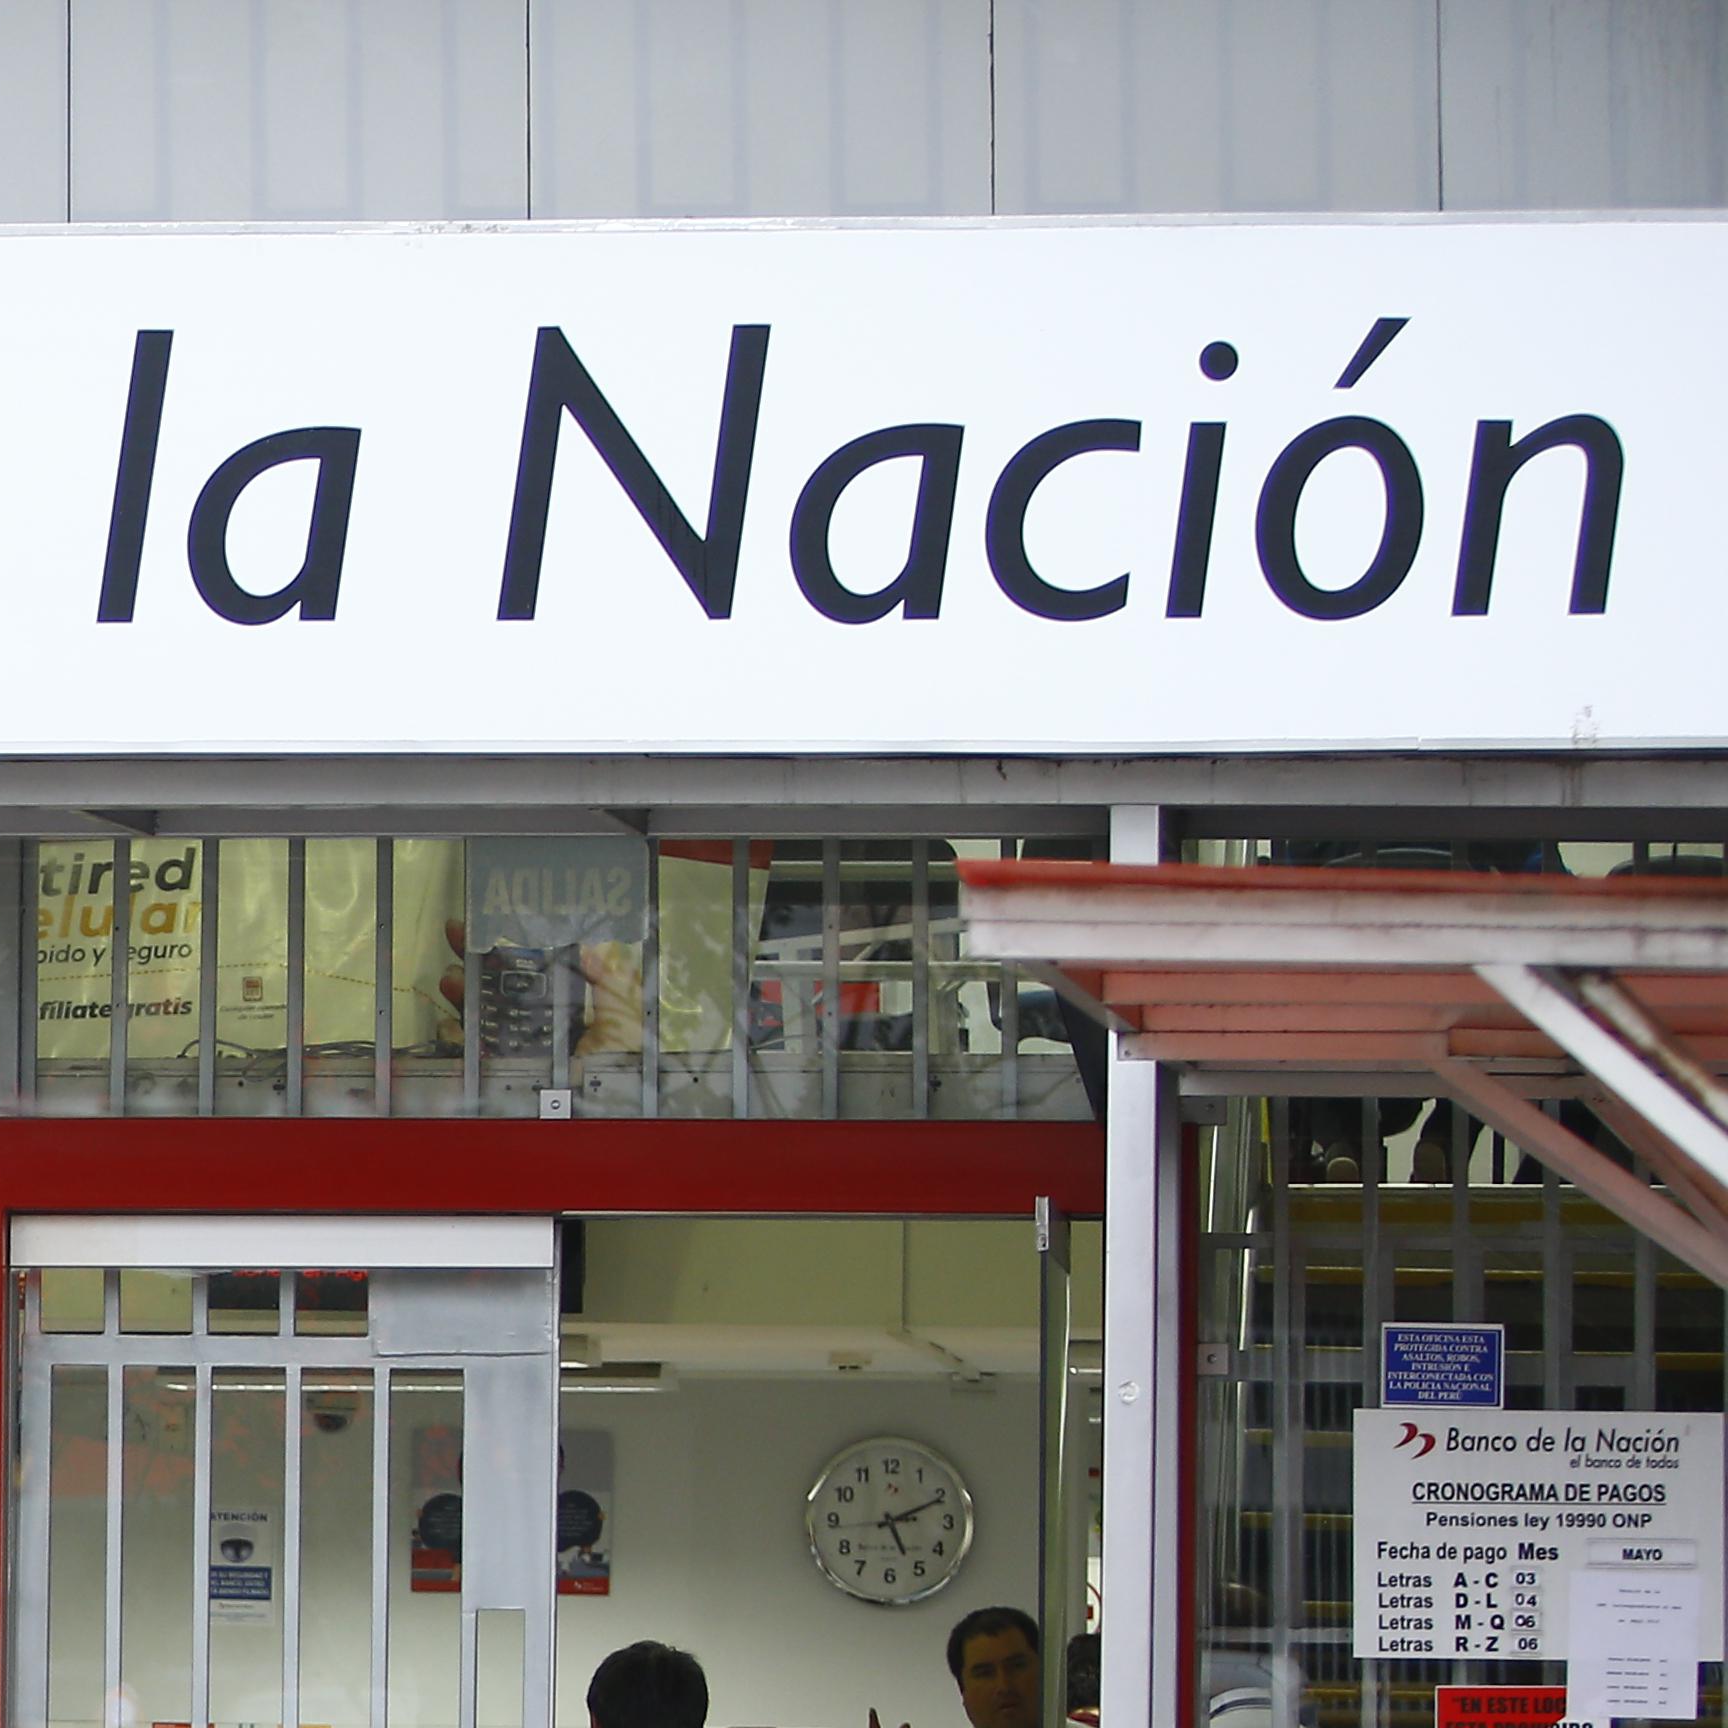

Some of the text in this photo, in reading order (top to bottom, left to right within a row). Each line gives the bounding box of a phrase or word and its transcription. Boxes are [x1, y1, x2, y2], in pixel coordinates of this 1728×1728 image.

[96, 329, 362, 626] la
[496, 317, 1625, 625] Nación
[1446, 1427, 1680, 1453] Banco de la Nación
[1412, 1482, 1666, 1502] CRONOGRAMA DE PAGOS
[1426, 1511, 1653, 1532] Pensiones ley 19990 ONP
[1377, 1541, 1559, 1565] Fecha de pago Mes
[1622, 1548, 1663, 1561] MAYO
[1377, 1571, 1433, 1588] Letras
[1453, 1572, 1468, 1588] A
[1484, 1572, 1499, 1589] C
[1515, 1572, 1536, 1586] 03
[1487, 1697, 1528, 1714] ESTE
